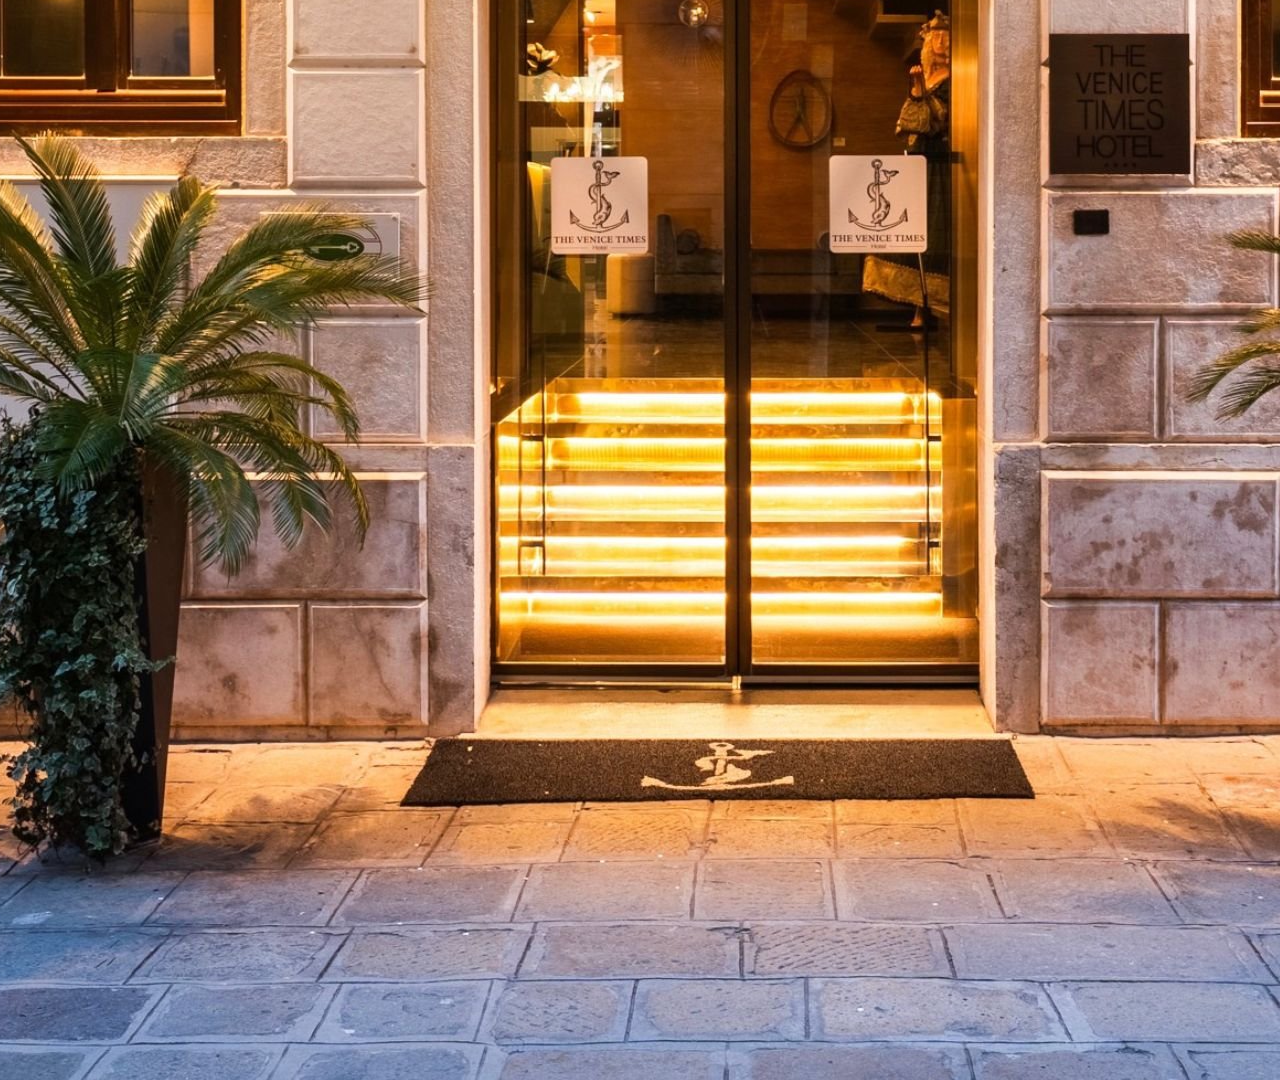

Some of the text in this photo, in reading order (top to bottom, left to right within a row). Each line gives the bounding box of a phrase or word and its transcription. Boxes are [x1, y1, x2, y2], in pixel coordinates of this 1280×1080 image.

[1092, 44, 1146, 68] THE
[1075, 71, 1164, 95] VENICE
[1077, 98, 1165, 131] TIMES
[1075, 134, 1164, 158] HOTEL
[553, 235, 646, 244] THE VENICE TIMES
[832, 234, 925, 243] THE VENICE TIMES
